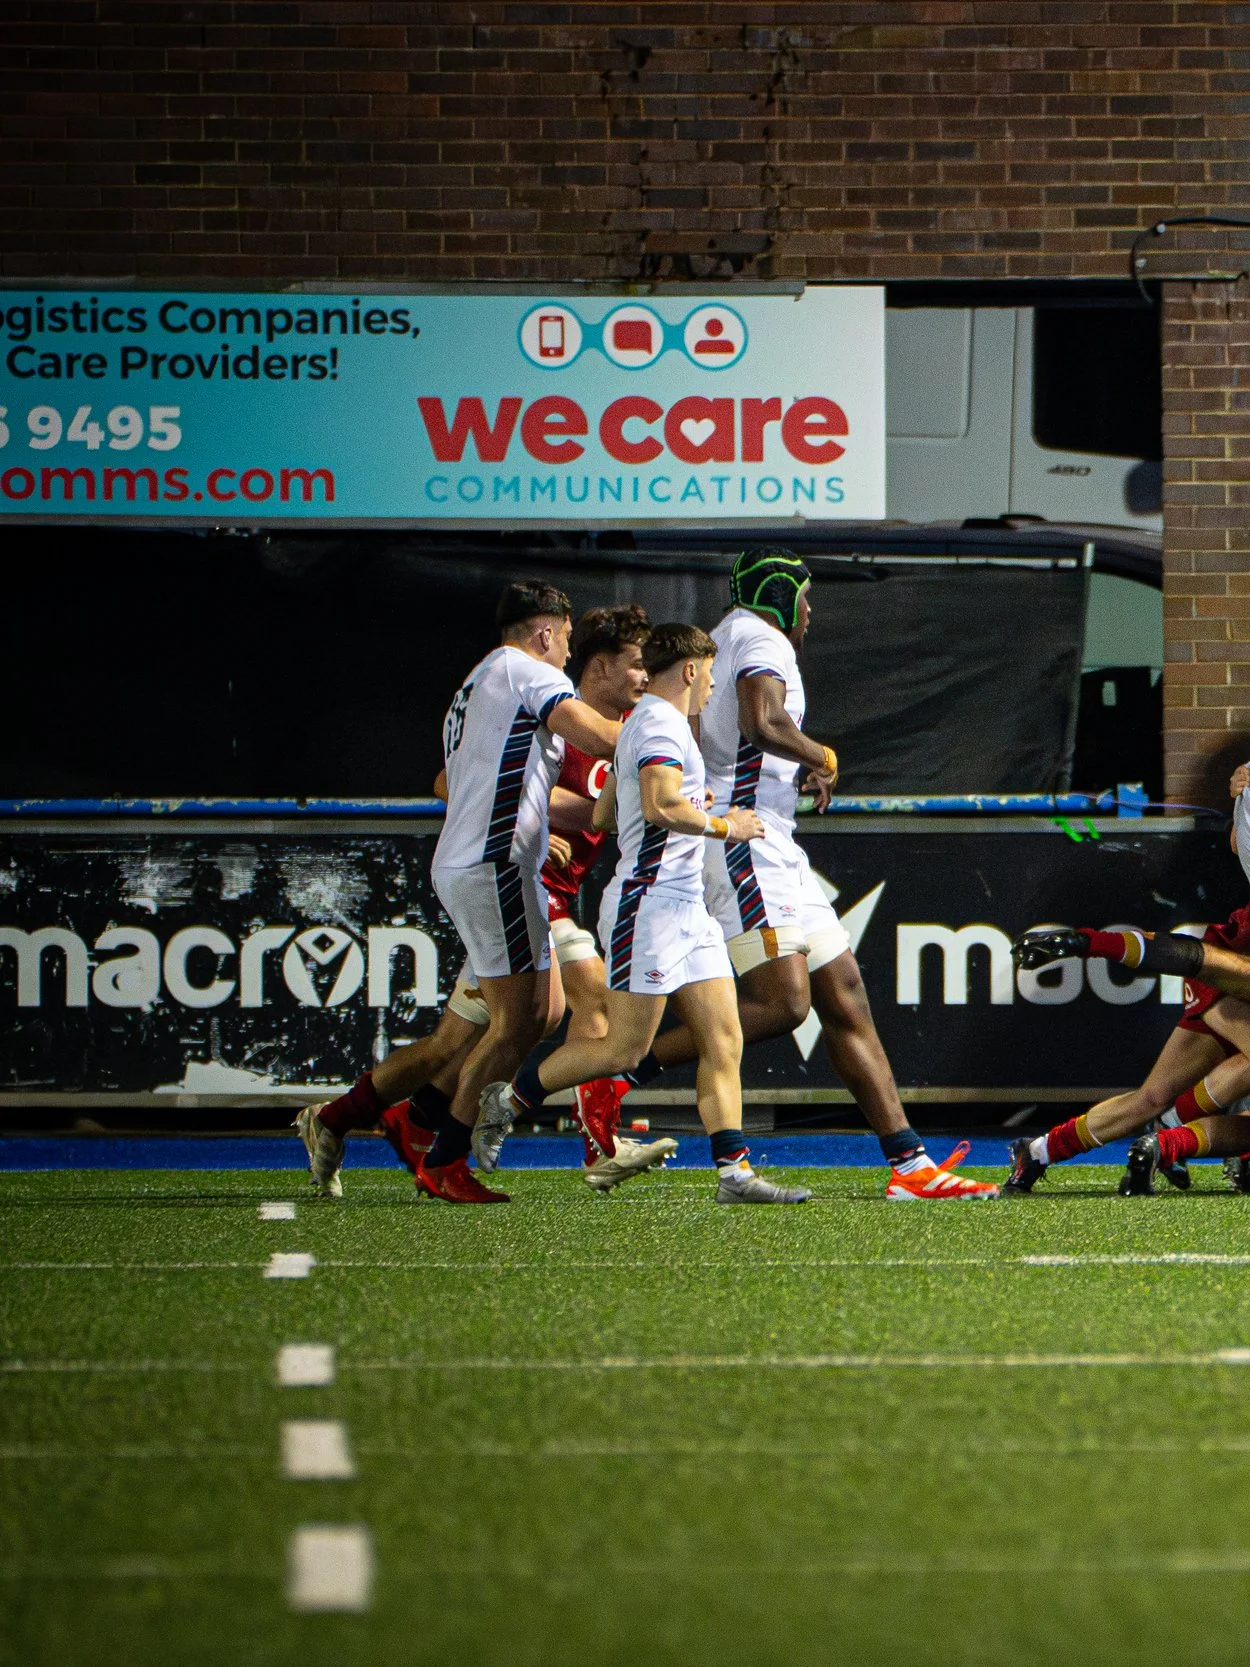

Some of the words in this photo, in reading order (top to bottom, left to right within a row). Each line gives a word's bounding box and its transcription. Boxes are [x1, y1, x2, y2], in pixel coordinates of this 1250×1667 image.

[0, 297, 147, 340] gistics
[158, 299, 421, 343] Companies,
[6, 347, 107, 379] Care
[120, 345, 339, 381] Providers!
[27, 406, 182, 450] 9495
[1, 466, 335, 502] omms.com
[424, 475, 845, 503] COMMUNICATIONS
